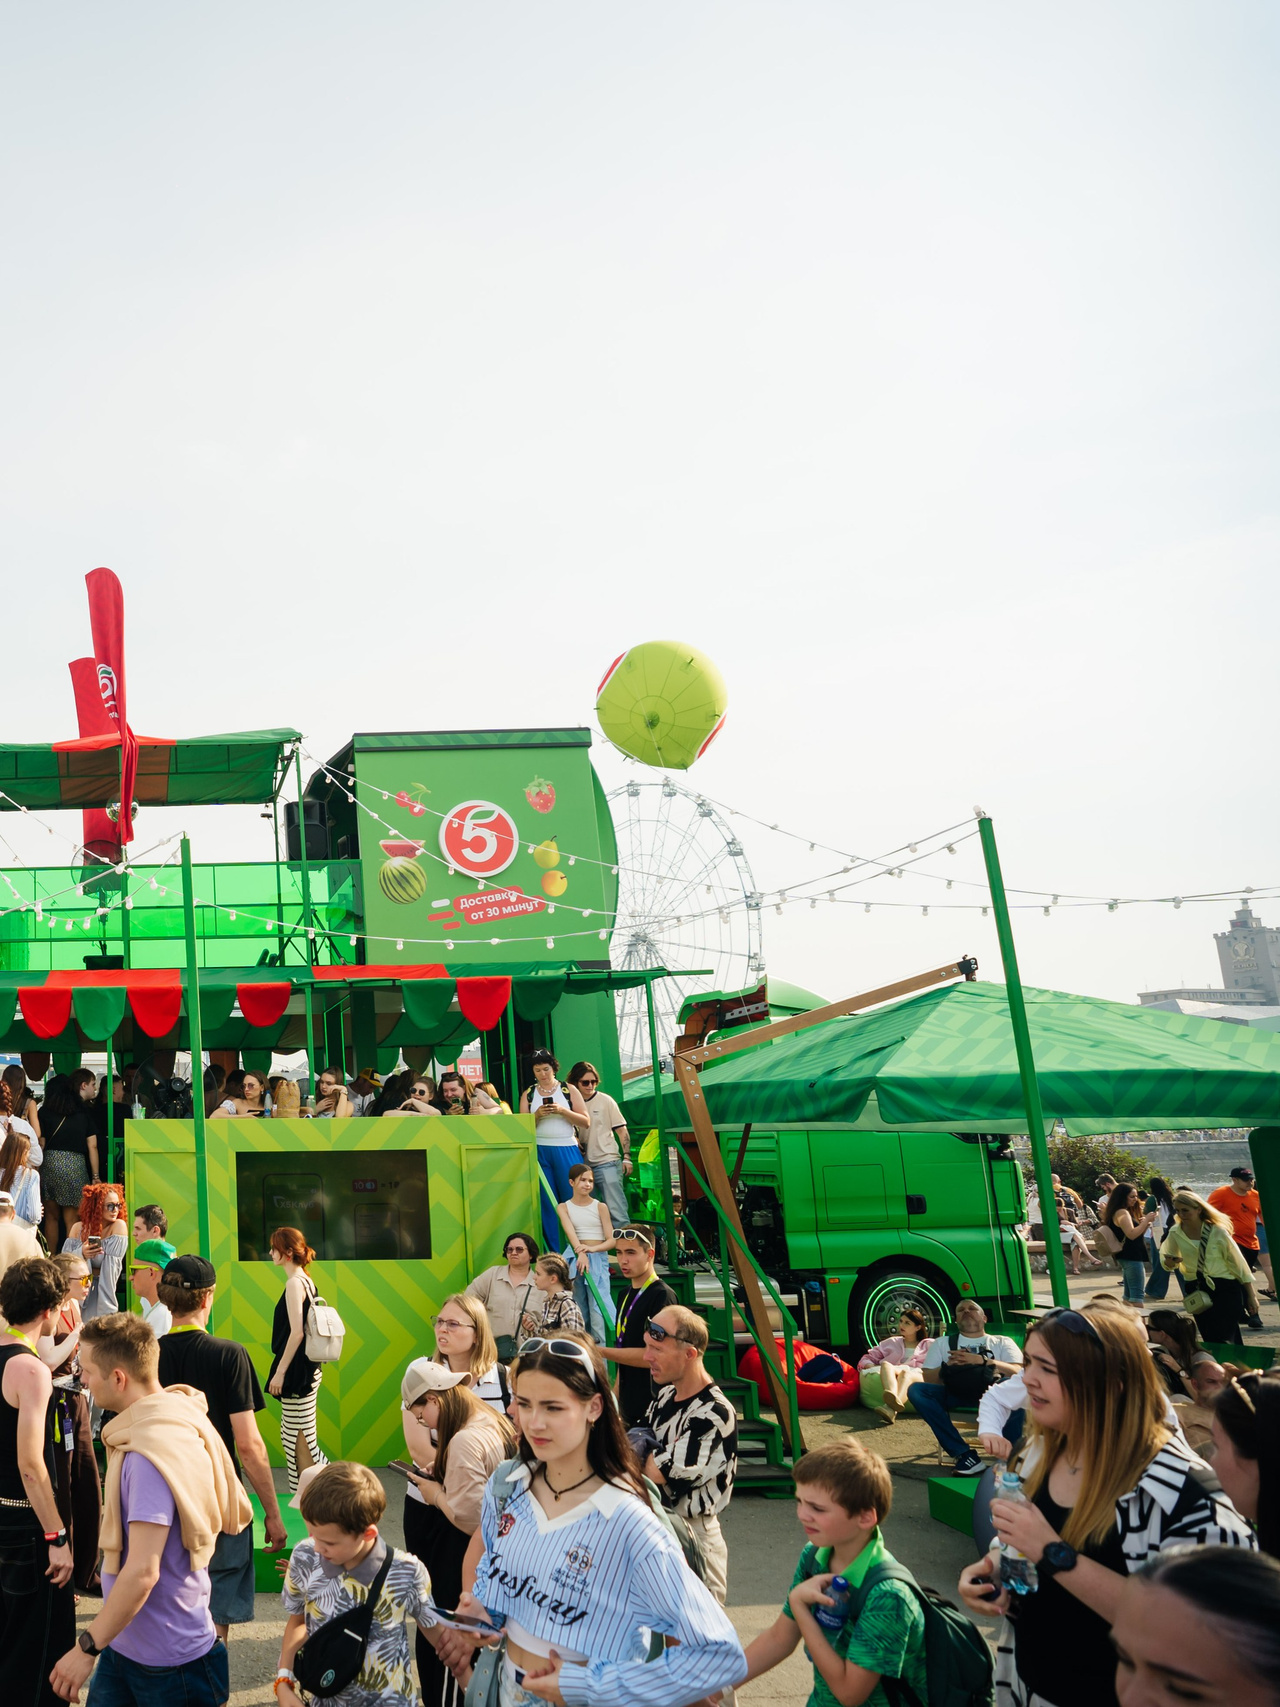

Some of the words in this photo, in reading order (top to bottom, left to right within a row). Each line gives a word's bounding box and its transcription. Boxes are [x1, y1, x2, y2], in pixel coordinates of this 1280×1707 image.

[461, 806, 500, 863] 5
[470, 911, 484, 920] от
[486, 907, 500, 917] 30
[502, 899, 539, 914] минут
[459, 1064, 482, 1076] ЛЕТ
